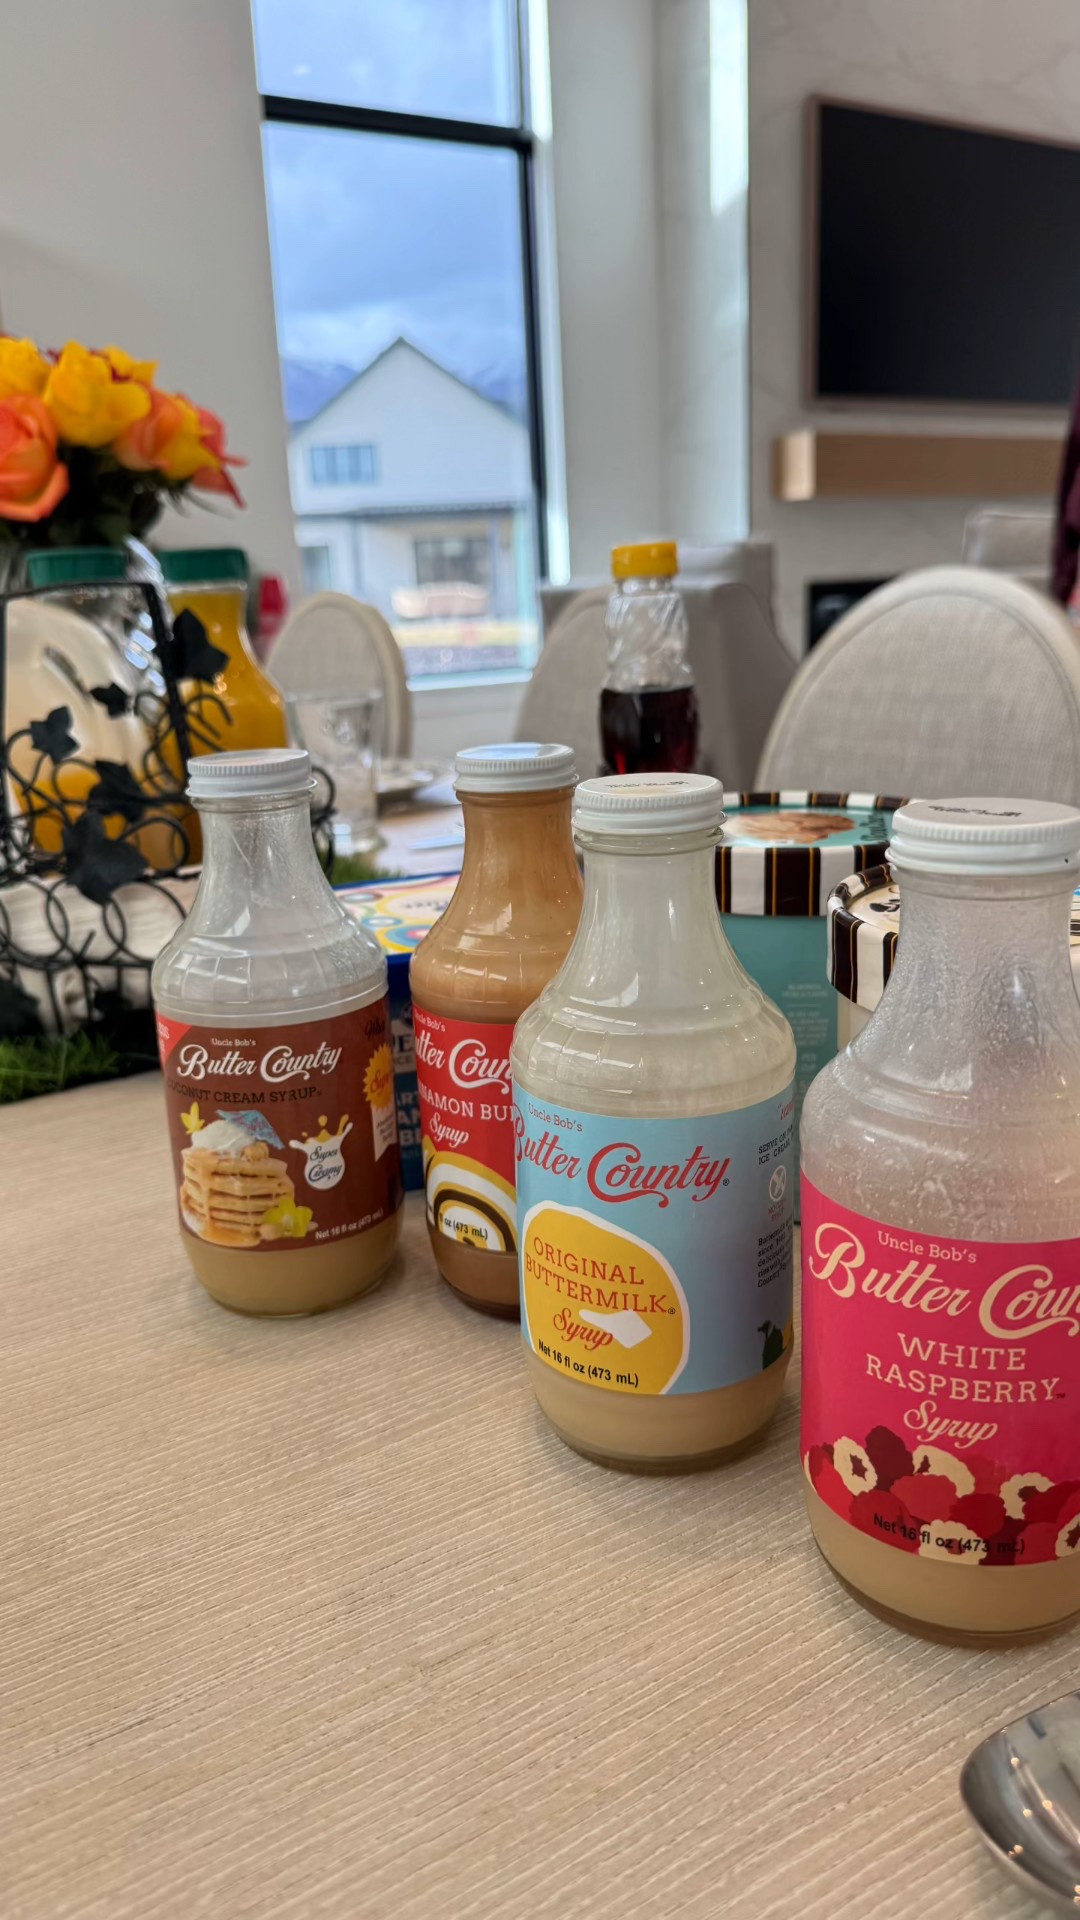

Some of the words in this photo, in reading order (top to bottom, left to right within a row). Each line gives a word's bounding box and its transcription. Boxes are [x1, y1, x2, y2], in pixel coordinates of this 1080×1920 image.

[427, 1017, 446, 1032] Bob's
[211, 1037, 234, 1047] Uncle
[235, 1038, 257, 1047] Bob's
[177, 1044, 257, 1081] Butter
[260, 1041, 343, 1083] Country
[213, 1090, 266, 1104] CREAM
[429, 1112, 470, 1148] Syrup
[527, 1102, 552, 1127] Uncle
[553, 1114, 583, 1132] Bob's
[309, 1145, 339, 1163] Super
[758, 1153, 771, 1165] ICE
[308, 1163, 343, 1182] Creamy
[315, 1229, 330, 1240] Net
[331, 1225, 340, 1237] 16
[341, 1223, 347, 1234] fl
[348, 1222, 357, 1231] oz
[453, 1219, 469, 1234] (473
[471, 1226, 488, 1241] mL)
[877, 1230, 924, 1256] Uncle
[928, 1244, 977, 1264] Bob's
[533, 1236, 644, 1285] ORIGINAL
[809, 1222, 972, 1317] Butter
[552, 1307, 614, 1351] Syrup
[538, 1337, 551, 1358] Net
[552, 1349, 563, 1365] 16
[564, 1355, 571, 1369] fl
[573, 1361, 585, 1374] oz
[588, 1363, 612, 1382] (473
[615, 1372, 639, 1388] mL)
[897, 1332, 1026, 1371] WHITE
[903, 1400, 998, 1449] Syrup
[873, 1513, 896, 1535] Net
[900, 1523, 917, 1541] 16
[920, 1530, 931, 1545] fl
[935, 1536, 954, 1549] oz
[957, 1536, 990, 1554] (473
[997, 1539, 1026, 1554] mL)
